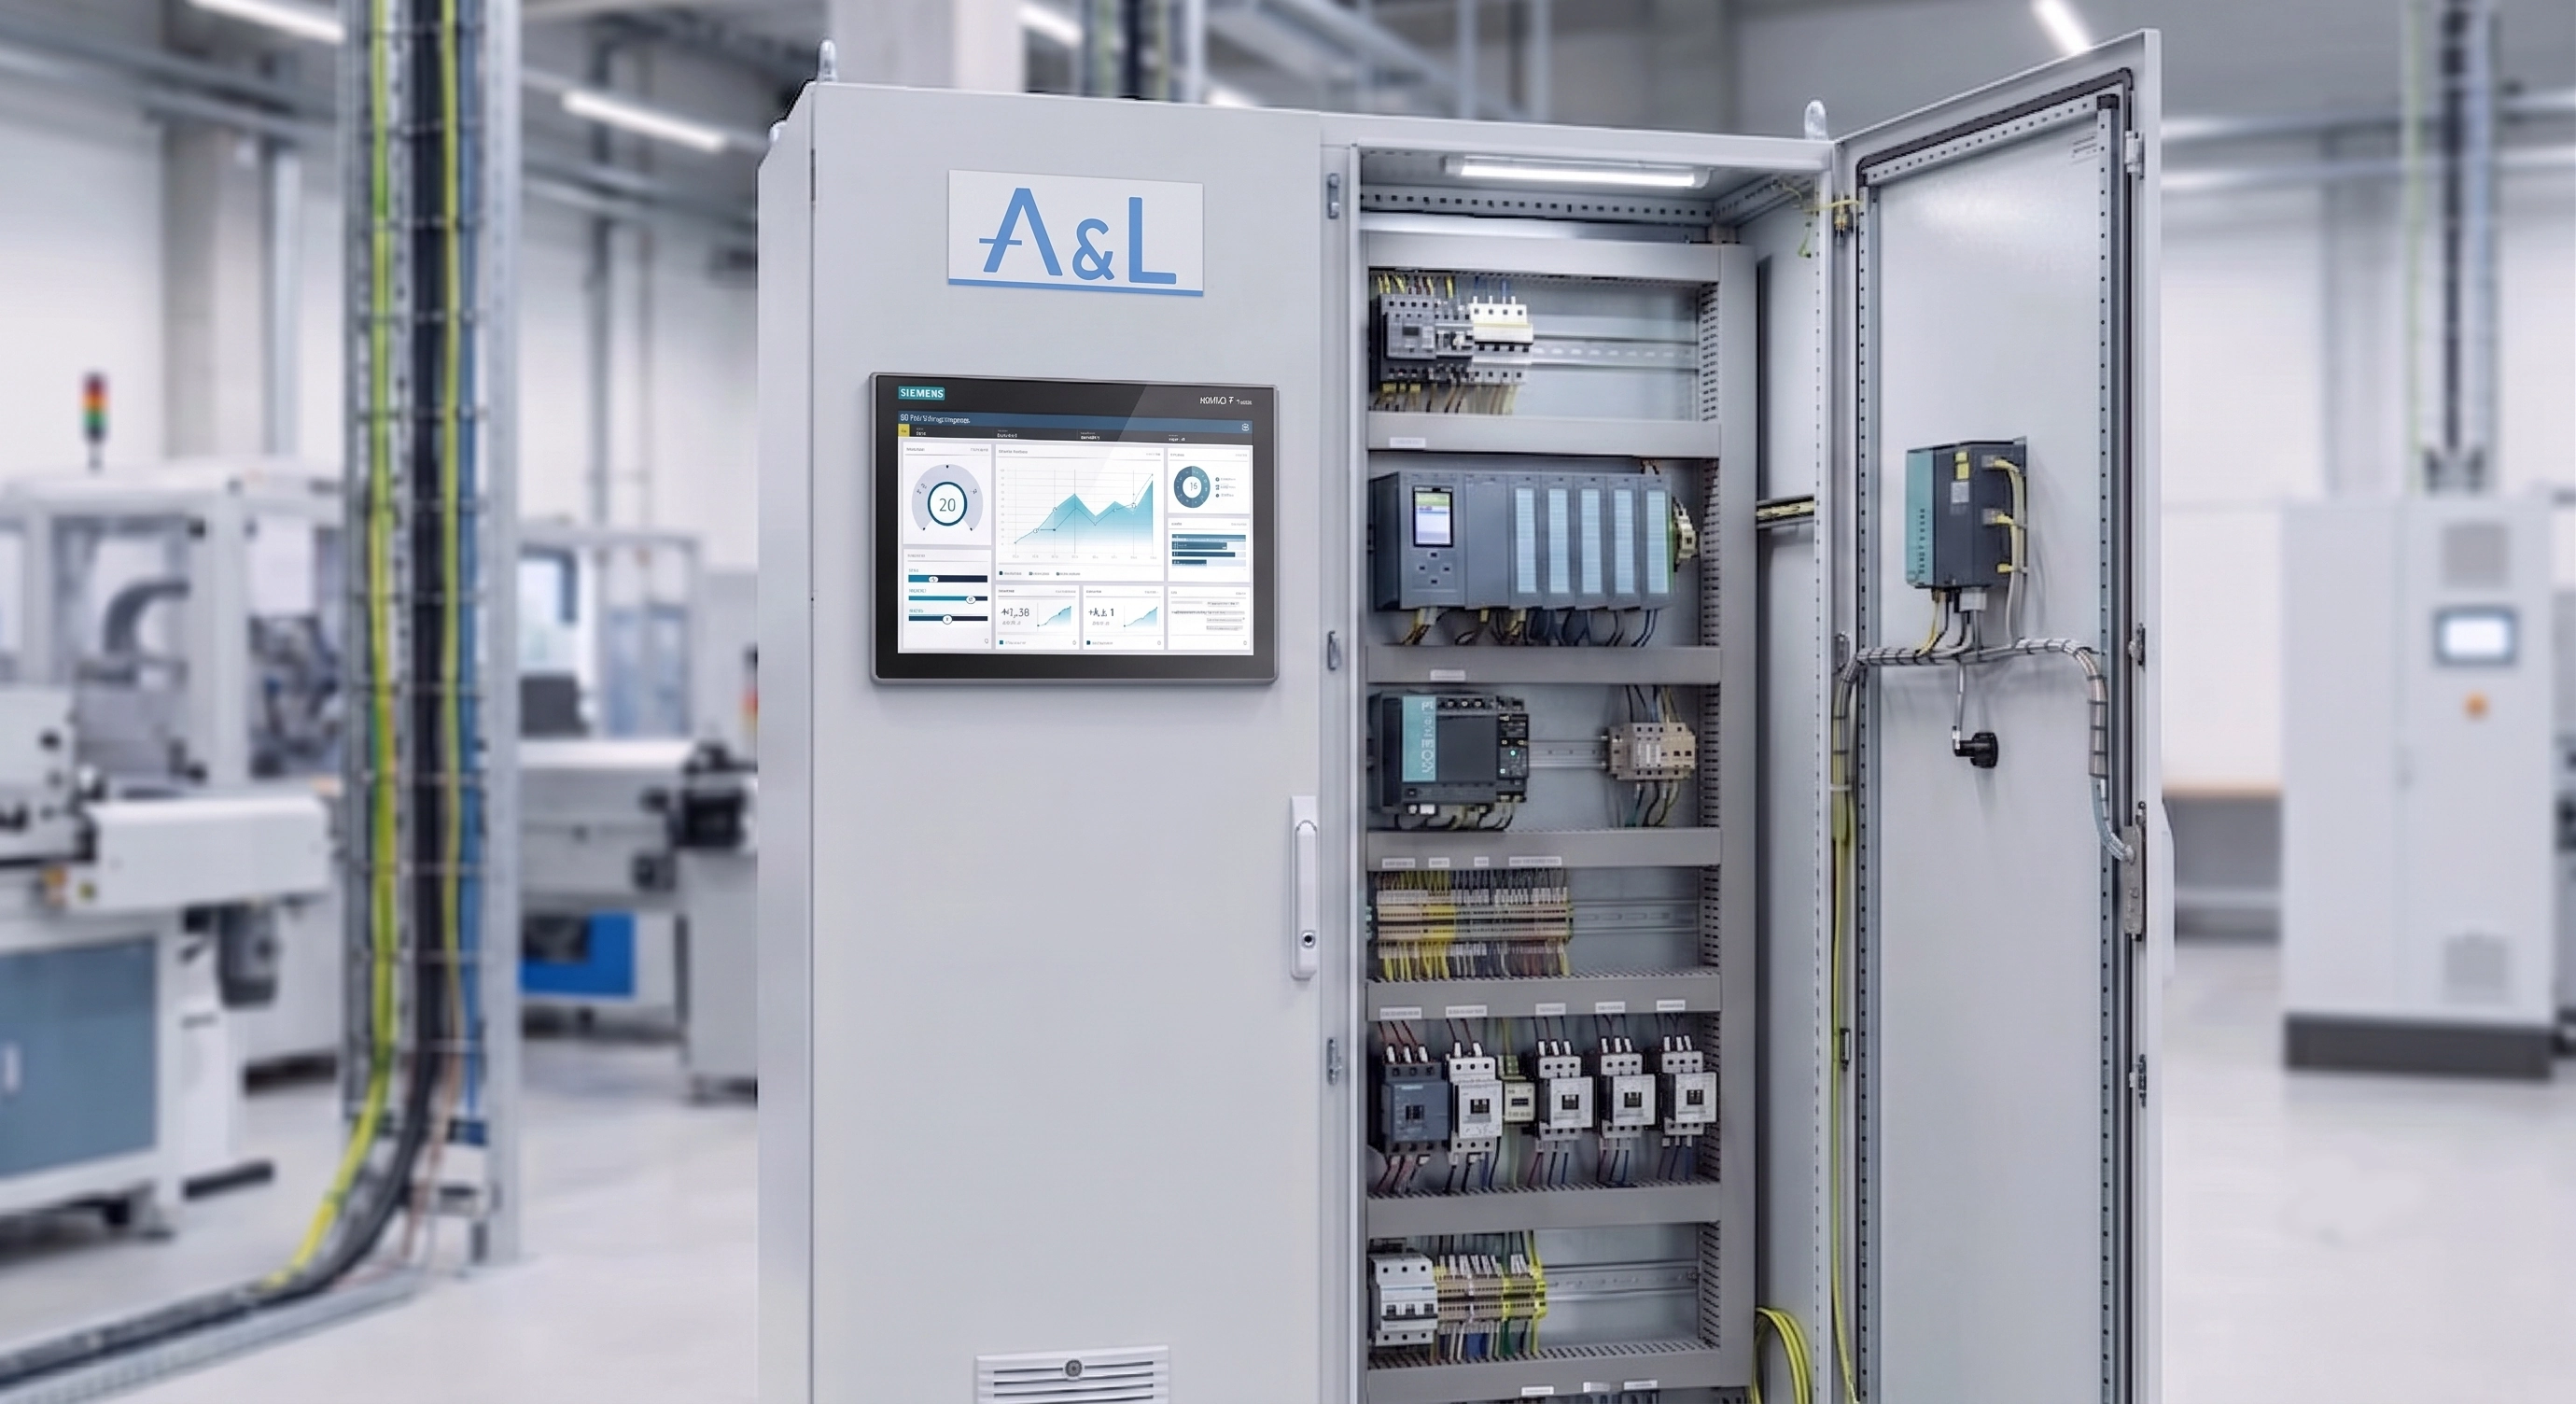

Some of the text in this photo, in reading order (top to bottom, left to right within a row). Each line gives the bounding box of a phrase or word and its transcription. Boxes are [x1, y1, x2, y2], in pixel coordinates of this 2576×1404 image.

[979, 187, 1177, 285] A&L
[900, 387, 944, 399] SIEMENS
[939, 498, 957, 512] 20
